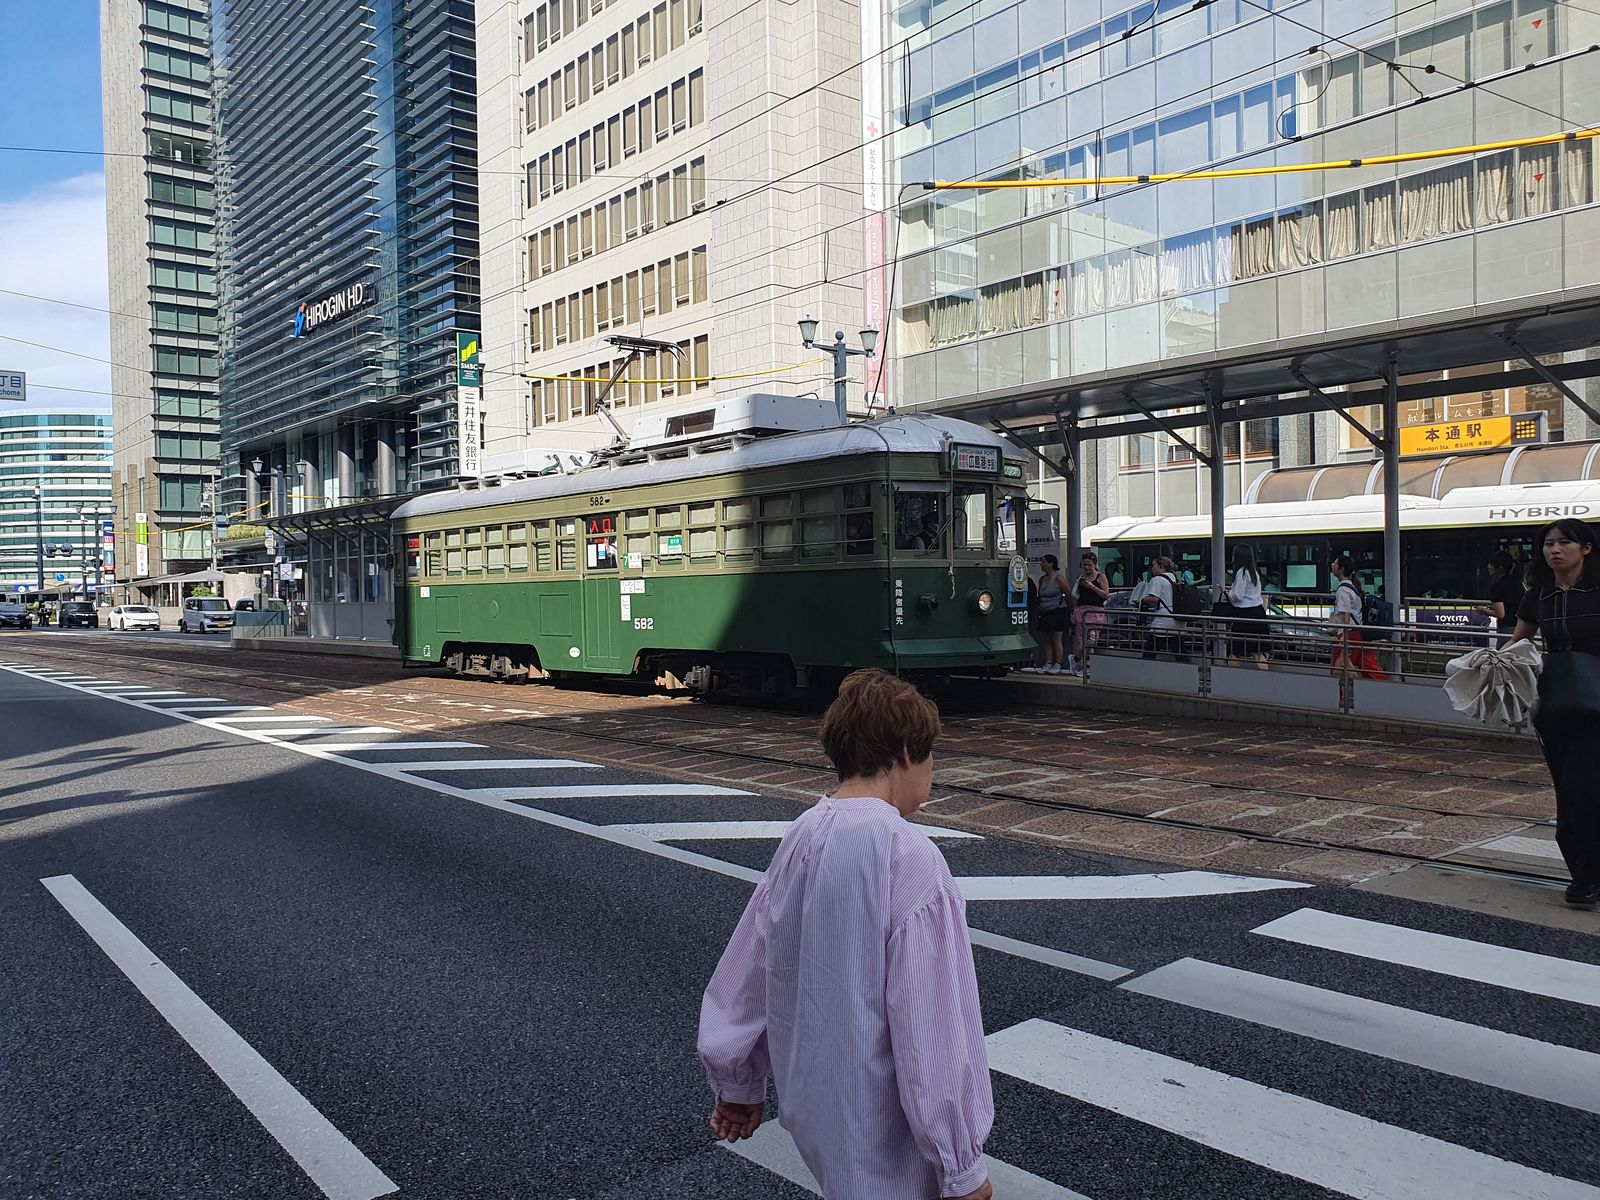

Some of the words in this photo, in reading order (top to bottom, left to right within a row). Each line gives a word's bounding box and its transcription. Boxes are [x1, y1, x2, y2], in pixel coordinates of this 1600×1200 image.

[306, 290, 346, 329] HIROGIN
[347, 283, 363, 309] HD
[464, 392, 477, 471] 三井住友銀行
[1425, 423, 1483, 443] 本通駅
[590, 496, 604, 506] 582
[1489, 505, 1591, 520] HYBRID
[634, 618, 654, 630] 582
[1011, 610, 1029, 625] 582
[1435, 615, 1469, 623] TOYOTA
